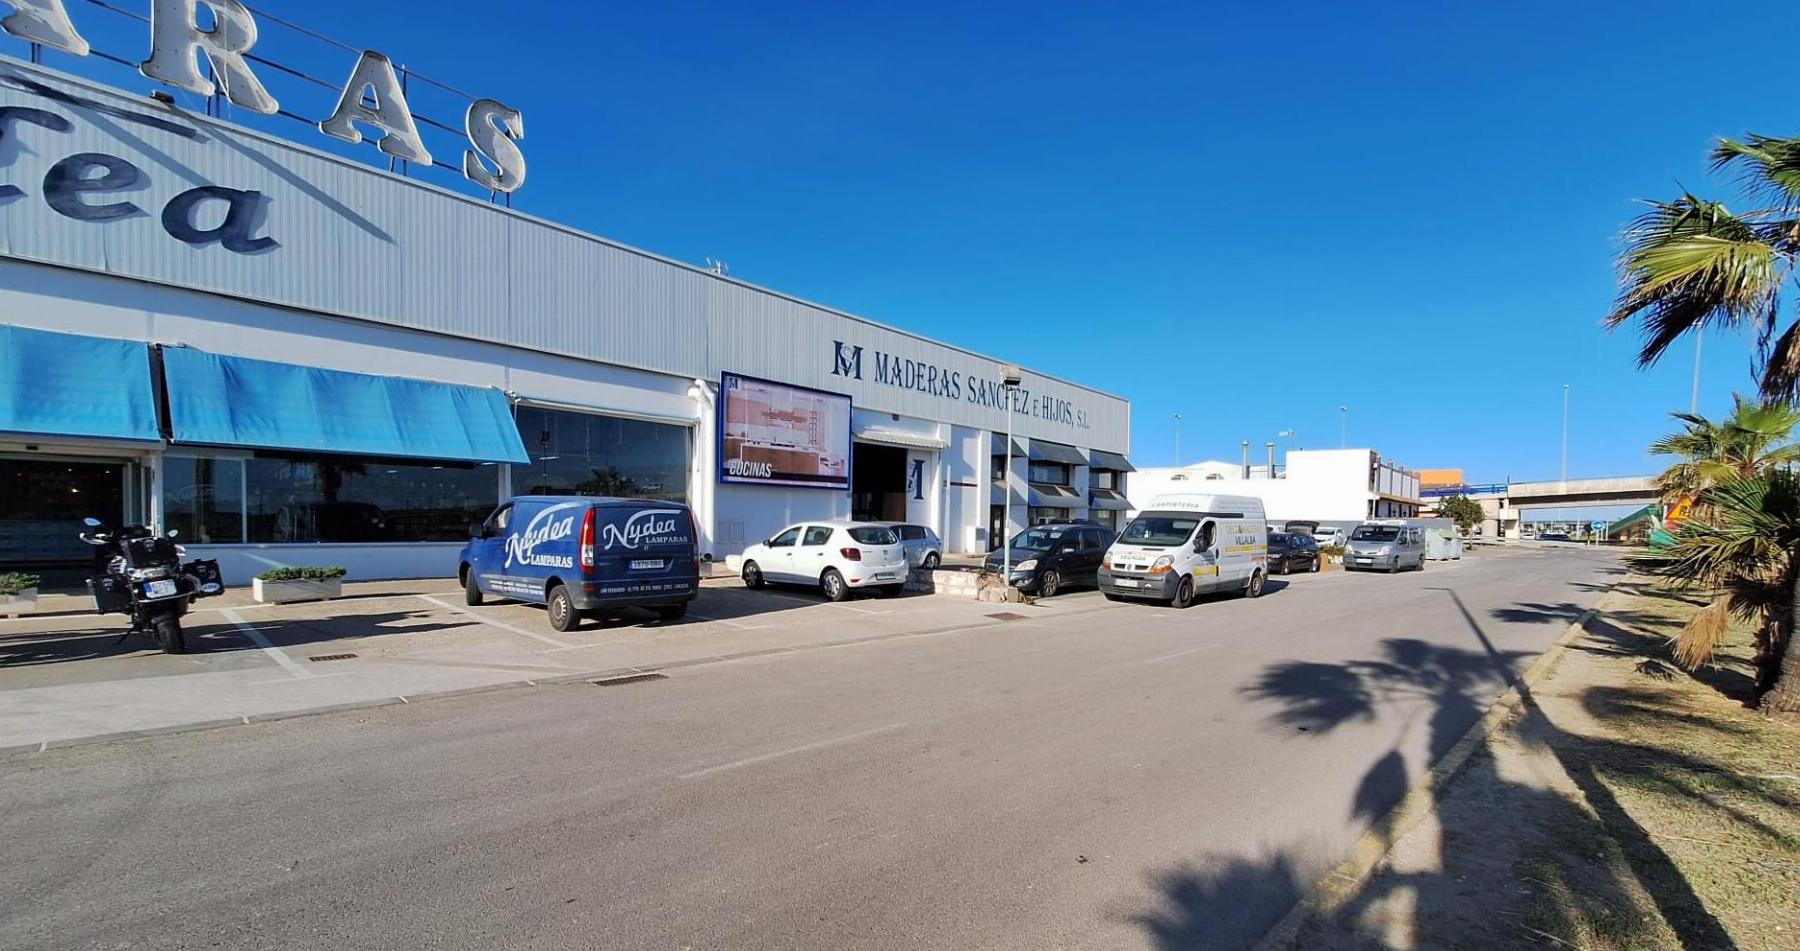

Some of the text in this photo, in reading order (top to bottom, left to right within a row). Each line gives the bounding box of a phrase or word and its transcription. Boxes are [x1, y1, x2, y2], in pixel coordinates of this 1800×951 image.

[874, 351, 961, 399] MADERAS
[1032, 399, 1039, 417] E
[1042, 395, 1074, 429] HIJOS,
[729, 461, 773, 478] COCINAS
[503, 502, 583, 568] Nydea
[602, 509, 682, 550] Nydea
[645, 536, 688, 544] LAMPARAS
[531, 554, 574, 568] LAMPARAS
